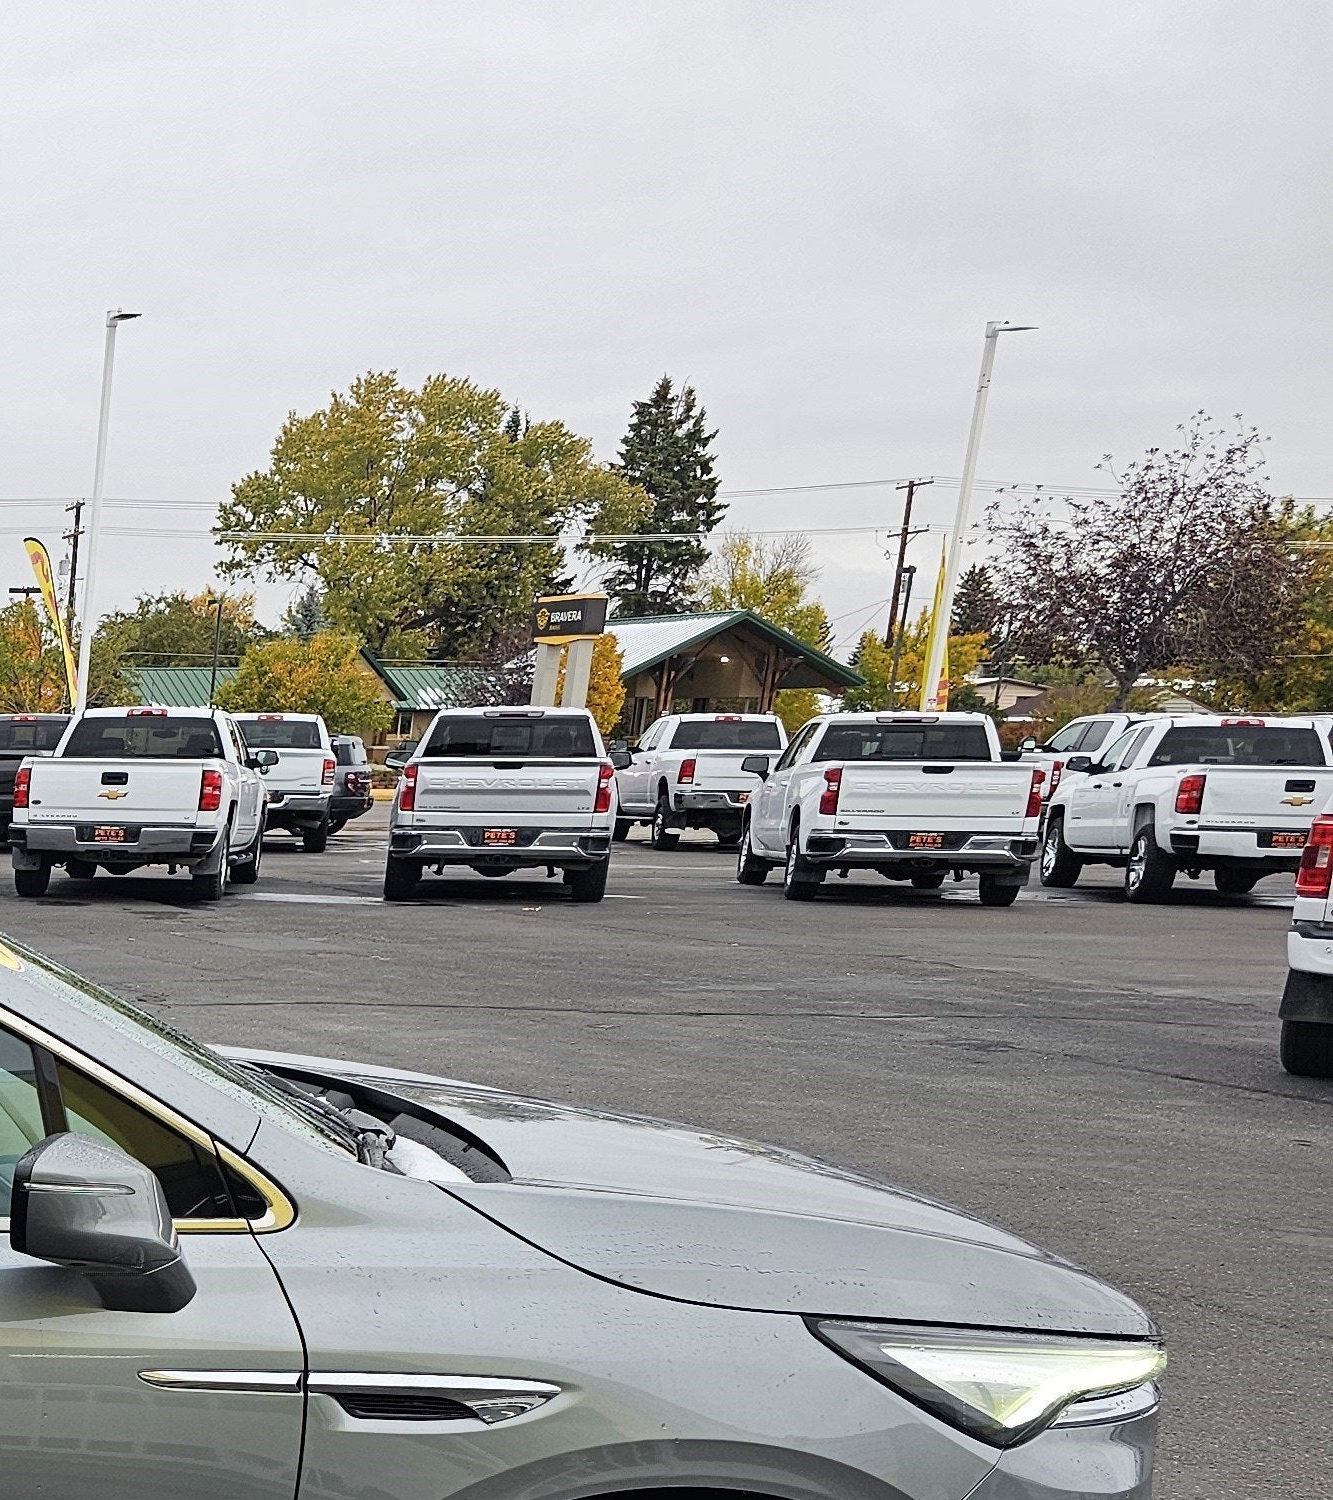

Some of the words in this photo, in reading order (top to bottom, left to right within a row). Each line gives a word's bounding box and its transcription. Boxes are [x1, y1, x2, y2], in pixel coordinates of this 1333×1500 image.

[550, 610, 582, 623] BRAVERA
[429, 778, 586, 789] CHEVROLET
[855, 782, 1018, 793] CHEVROLET
[484, 831, 516, 839] PETE'S
[910, 835, 942, 843] PETE'S
[1272, 835, 1305, 843] PETE'S
